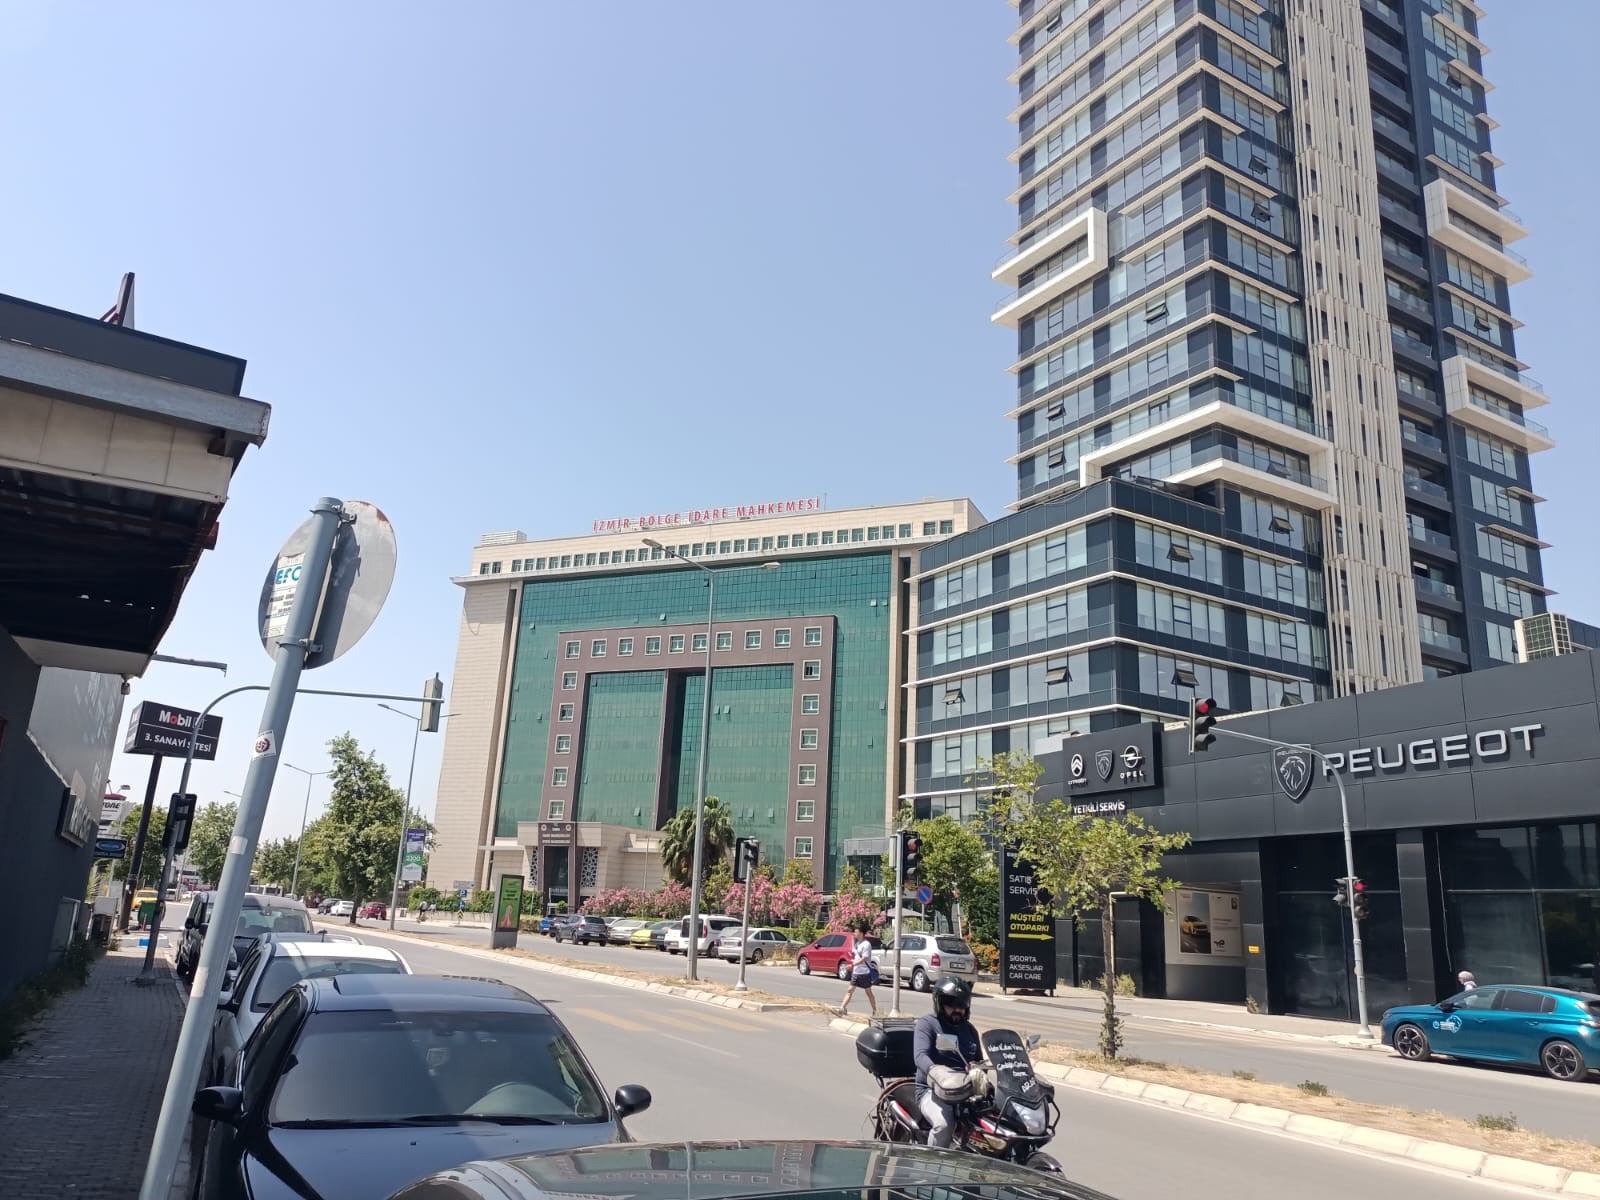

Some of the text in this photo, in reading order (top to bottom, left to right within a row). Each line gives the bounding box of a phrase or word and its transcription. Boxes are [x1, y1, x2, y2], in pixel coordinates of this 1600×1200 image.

[159, 710, 193, 728] Mobil
[144, 733, 212, 753] 3. SANAYİ STESİ
[1322, 723, 1542, 777] PEUGEOT
[1120, 770, 1144, 780] OPEL
[1099, 799, 1126, 812] SERVİS
